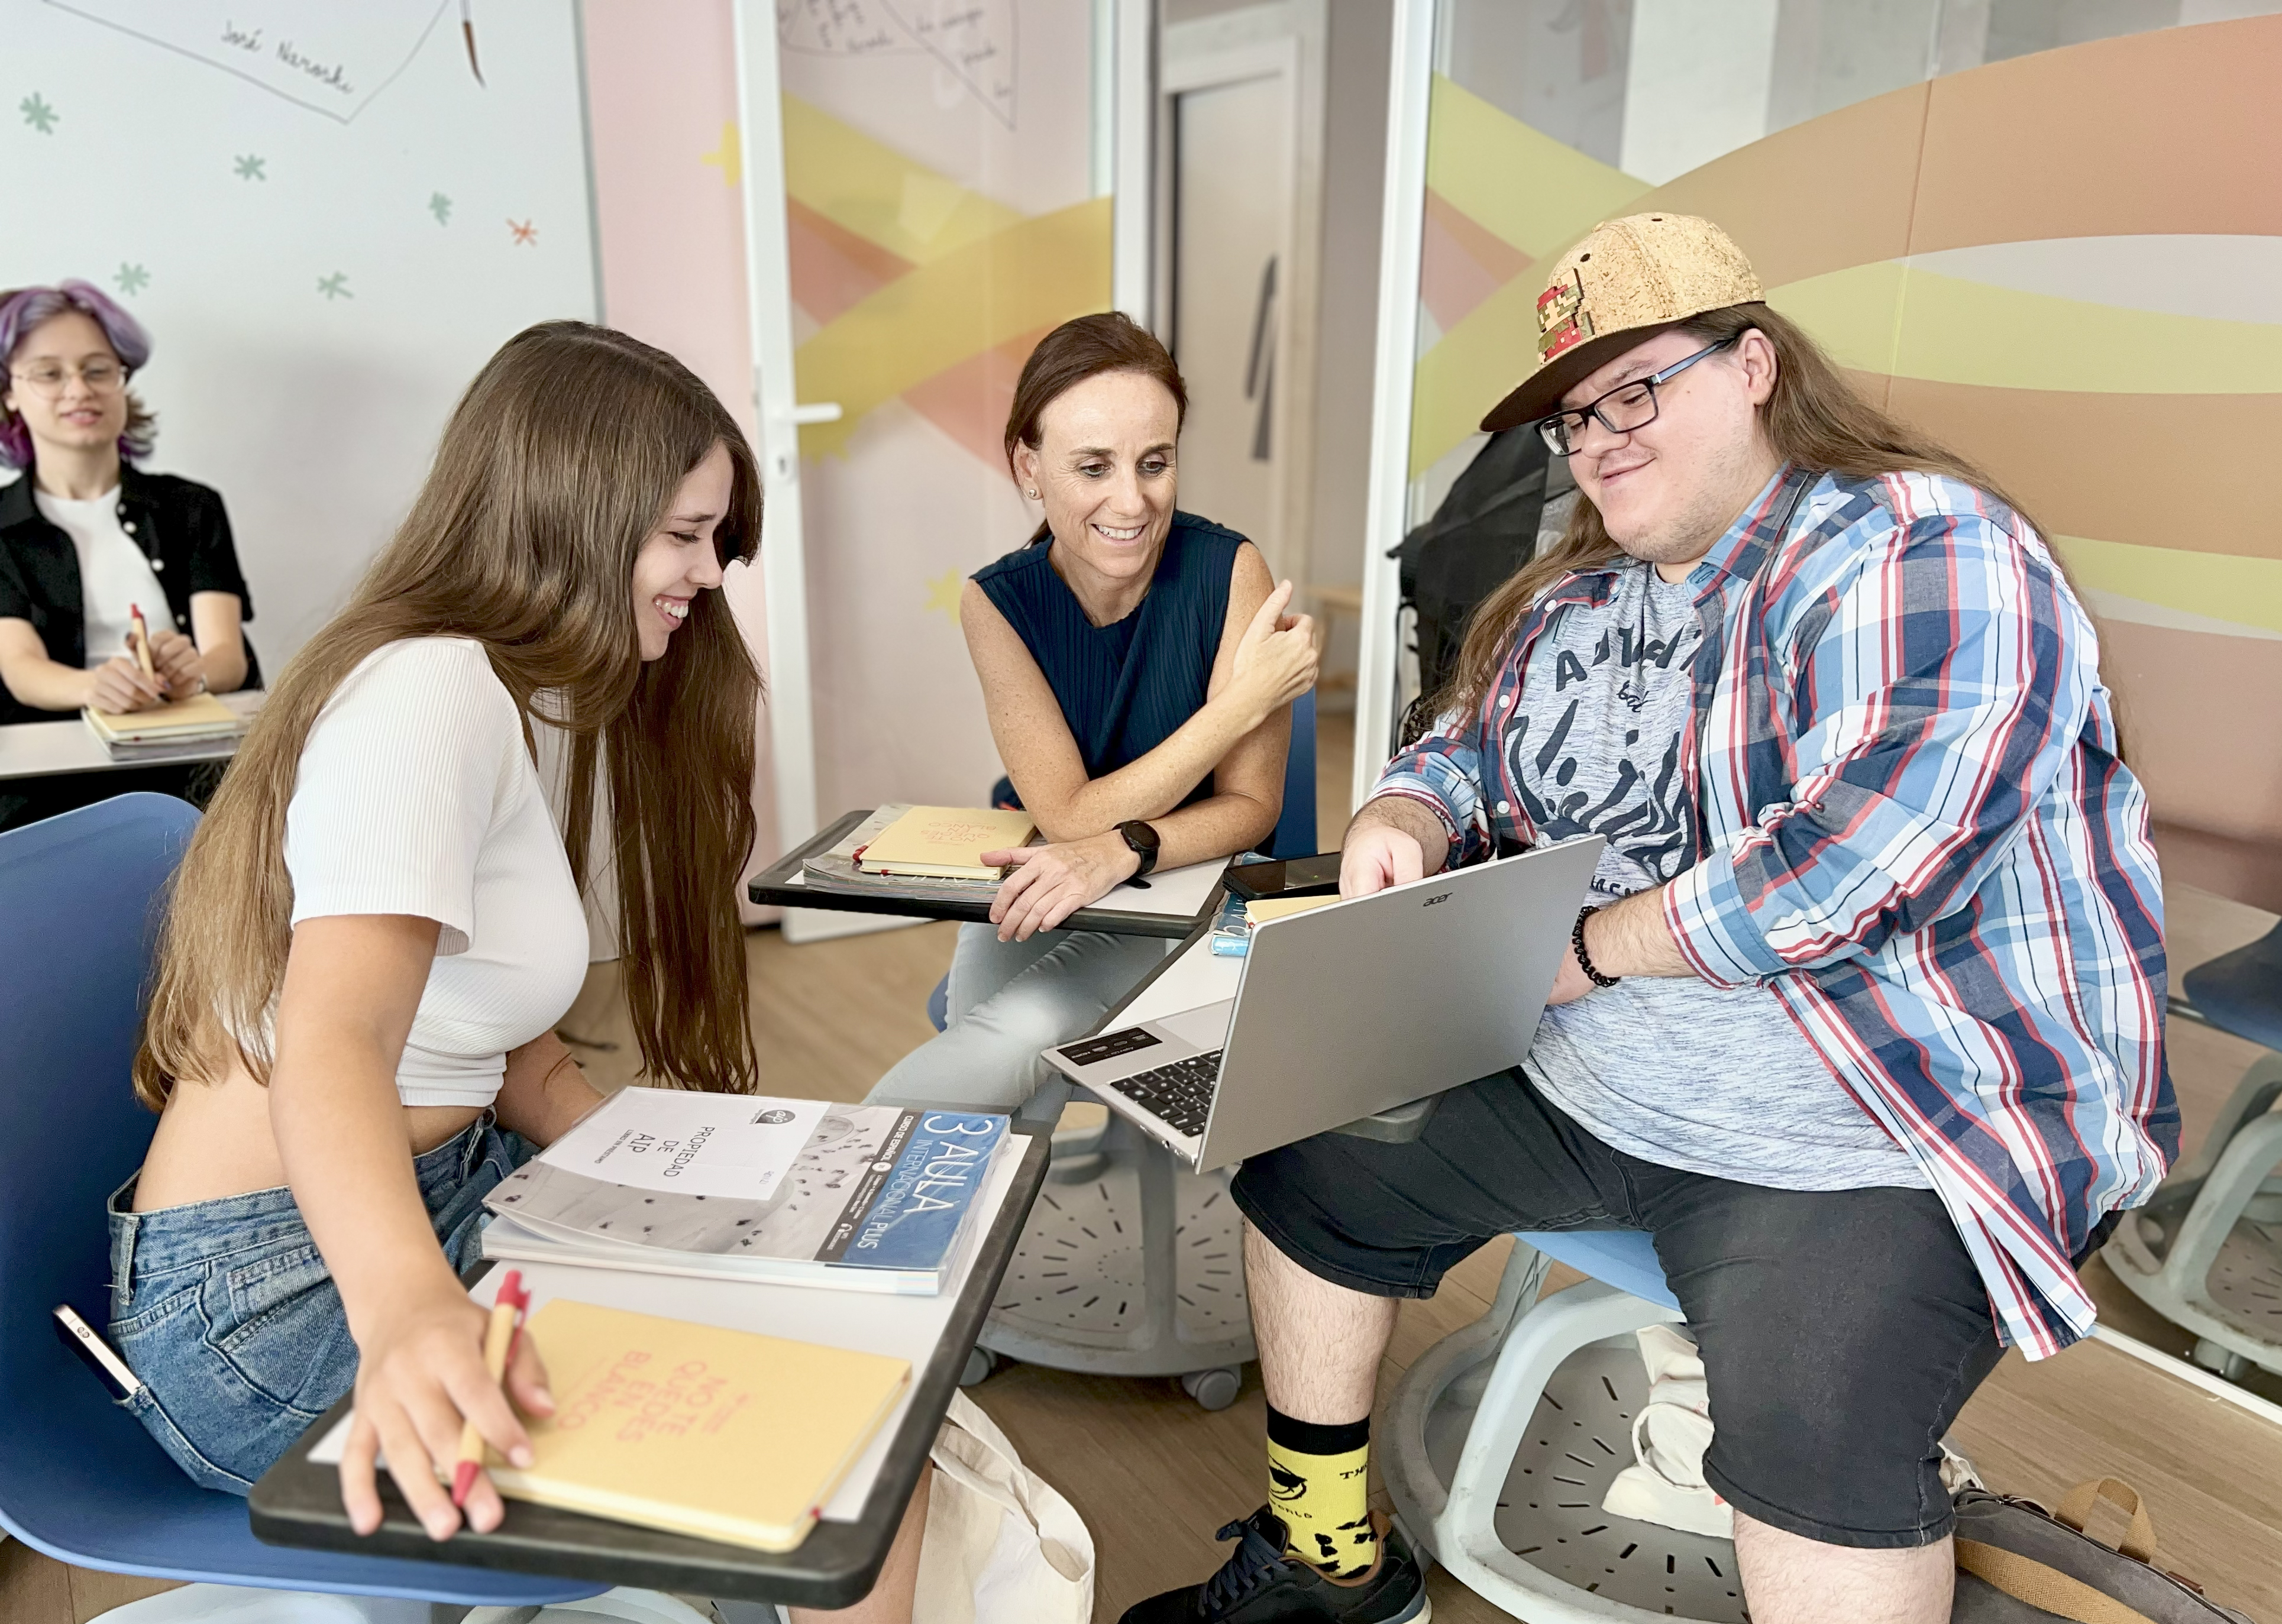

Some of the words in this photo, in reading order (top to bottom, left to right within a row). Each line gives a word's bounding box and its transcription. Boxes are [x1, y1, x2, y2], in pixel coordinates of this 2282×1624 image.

[1423, 892, 1453, 907] acer
[924, 1115, 993, 1135] 3
[627, 1133, 656, 1153] AIP
[657, 1140, 680, 1153] DE
[663, 1127, 715, 1177] PROPIEDAD
[880, 1138, 901, 1162] ESPAÑOL
[872, 1139, 933, 1221] INTERNACIONAL
[903, 1141, 979, 1213] AULA
[857, 1222, 888, 1250] PLUS
[558, 1351, 652, 1430] BLANCO
[613, 1380, 656, 1410] EN
[616, 1360, 707, 1441] QUEDES
[686, 1376, 728, 1407] NO
[656, 1413, 698, 1437] TE
